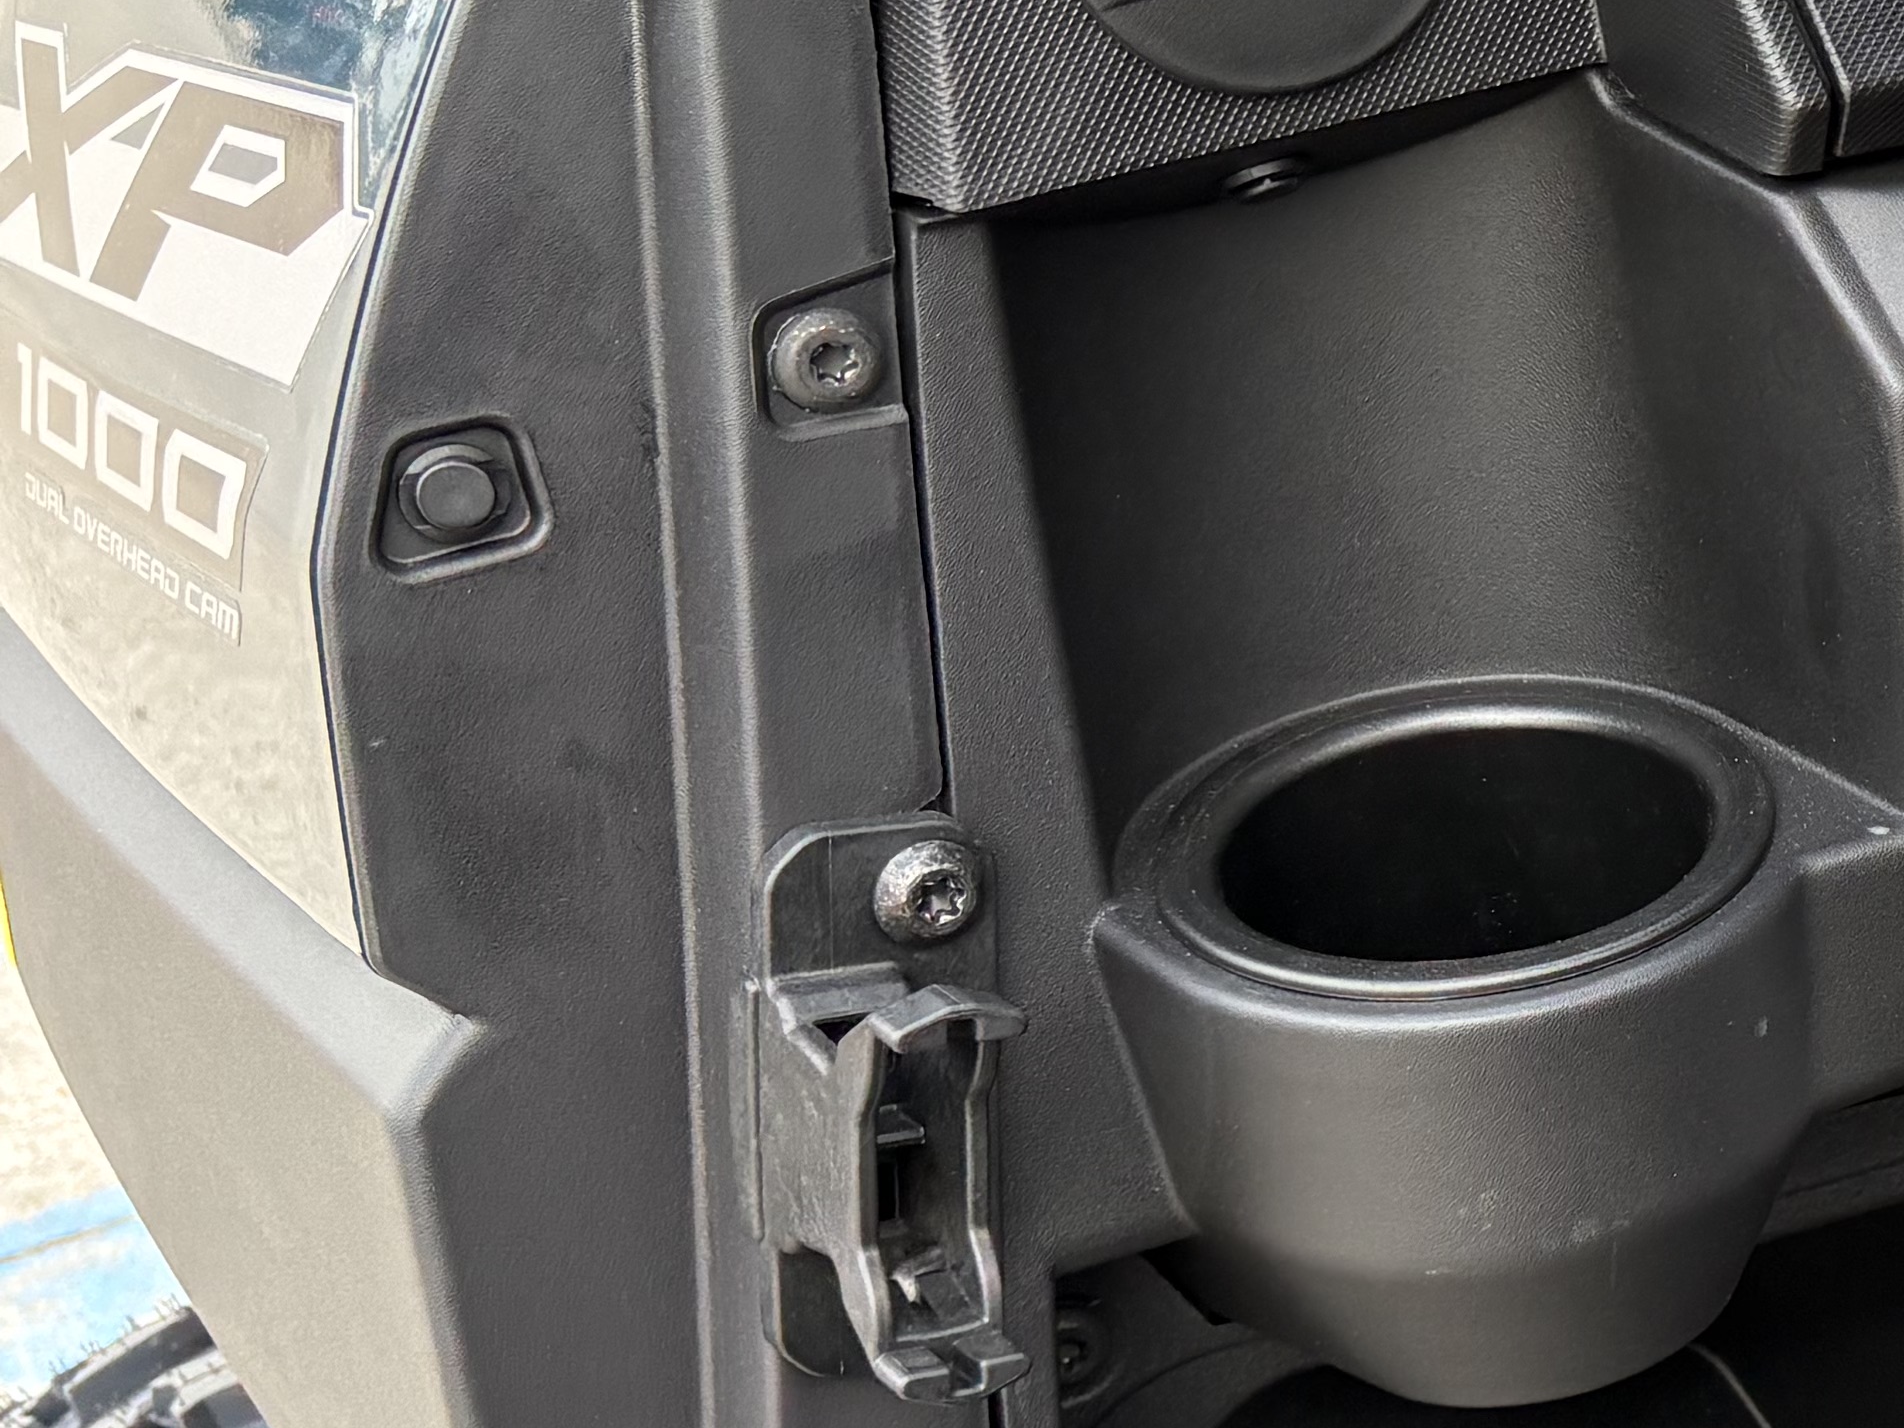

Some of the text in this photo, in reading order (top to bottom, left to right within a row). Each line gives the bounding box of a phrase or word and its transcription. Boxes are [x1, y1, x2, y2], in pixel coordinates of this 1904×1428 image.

[0, 22, 358, 304] XP
[15, 340, 248, 562] 1000
[24, 471, 242, 642] DUAL OVERHEAD CAM
